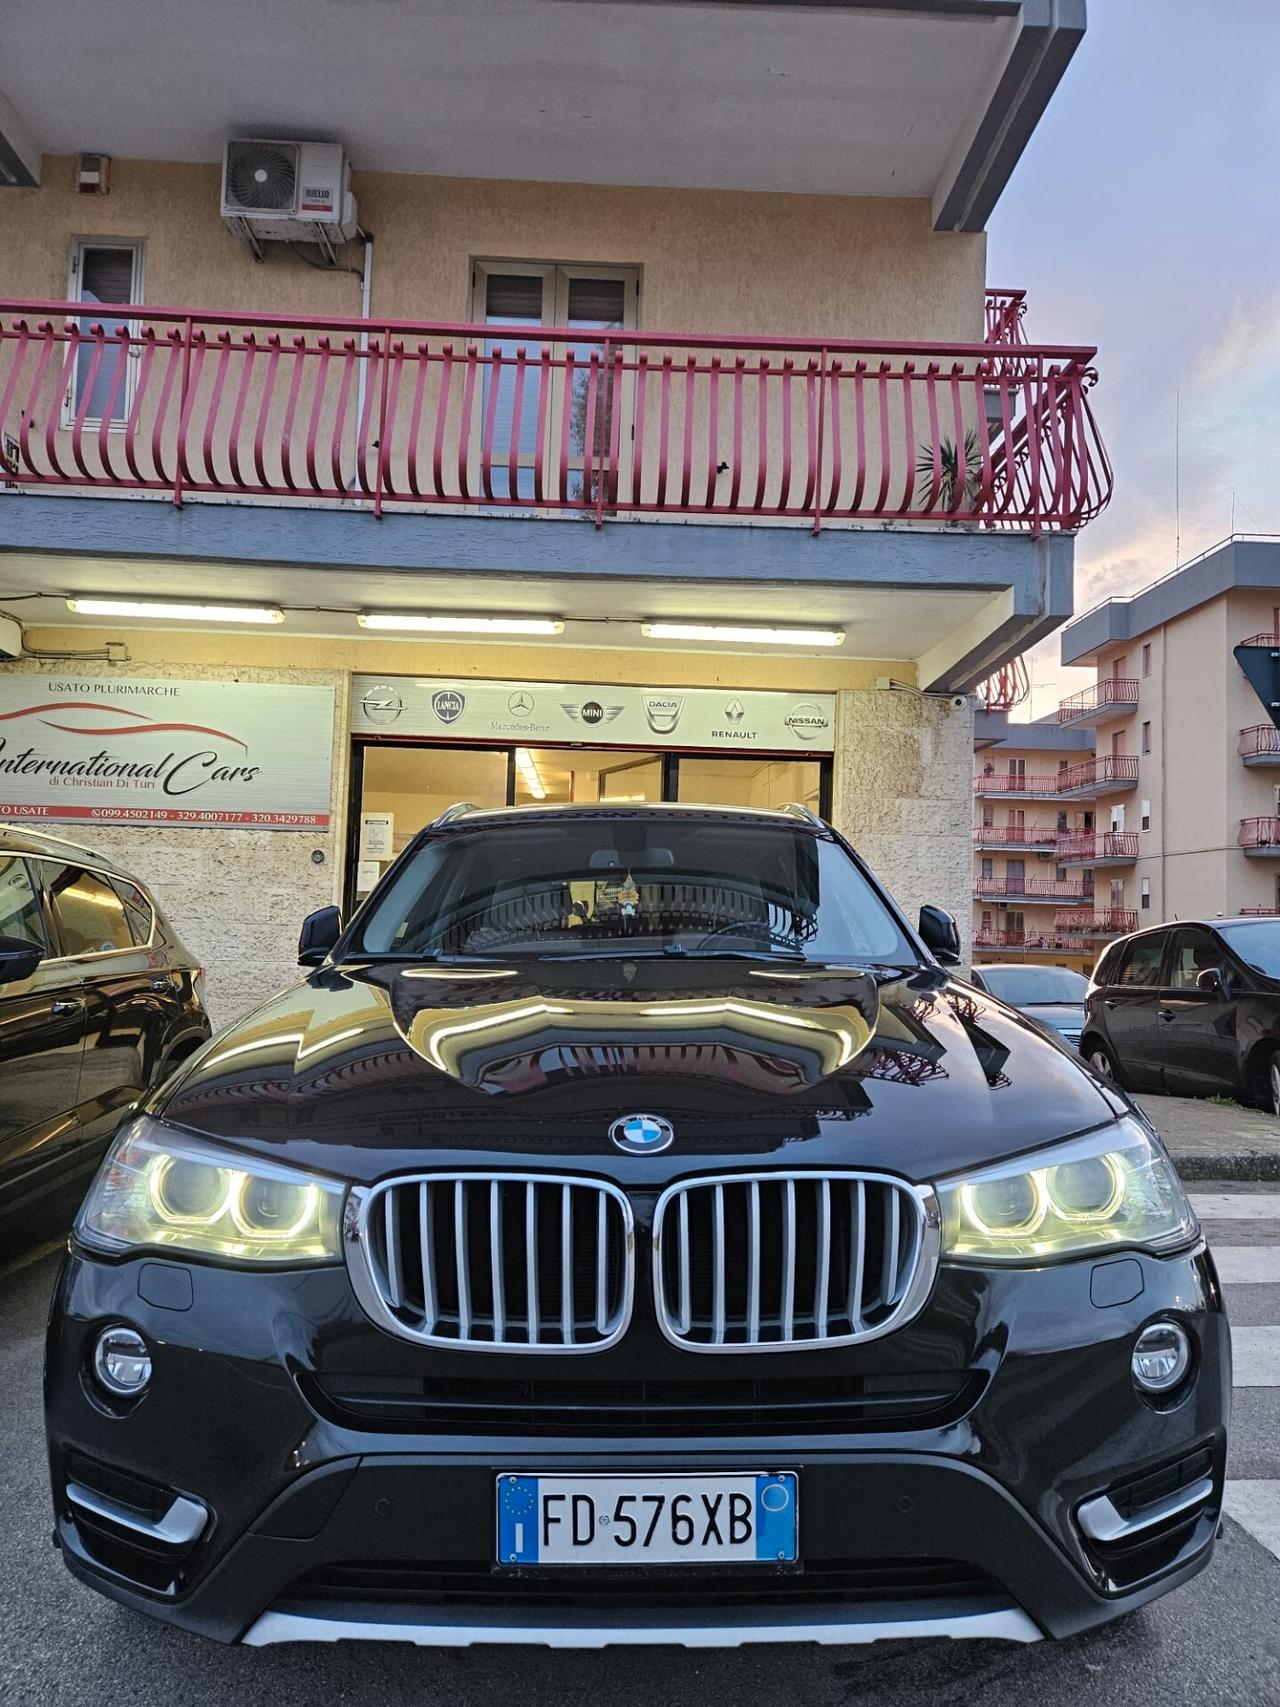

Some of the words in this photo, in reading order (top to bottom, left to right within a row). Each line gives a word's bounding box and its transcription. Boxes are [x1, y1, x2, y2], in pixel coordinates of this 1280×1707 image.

[48, 682, 90, 693] USATO
[94, 684, 181, 697] PLURIMARCHE
[437, 700, 460, 711] LANCIA
[582, 708, 603, 718] MINI
[788, 717, 825, 725] NISSAN
[711, 730, 758, 739] RENAULT
[163, 751, 261, 796] Cars
[49, 776, 60, 787] di
[63, 777, 113, 788] Christian
[116, 779, 129, 788] Di
[133, 779, 155, 789] Turi
[14, 806, 49, 816] USATE
[101, 808, 168, 819] 099.4502149
[177, 811, 242, 822] 329.4007177
[251, 813, 316, 824] 320.3429788
[542, 1494, 595, 1546] FD
[613, 1493, 752, 1547] 576XB
